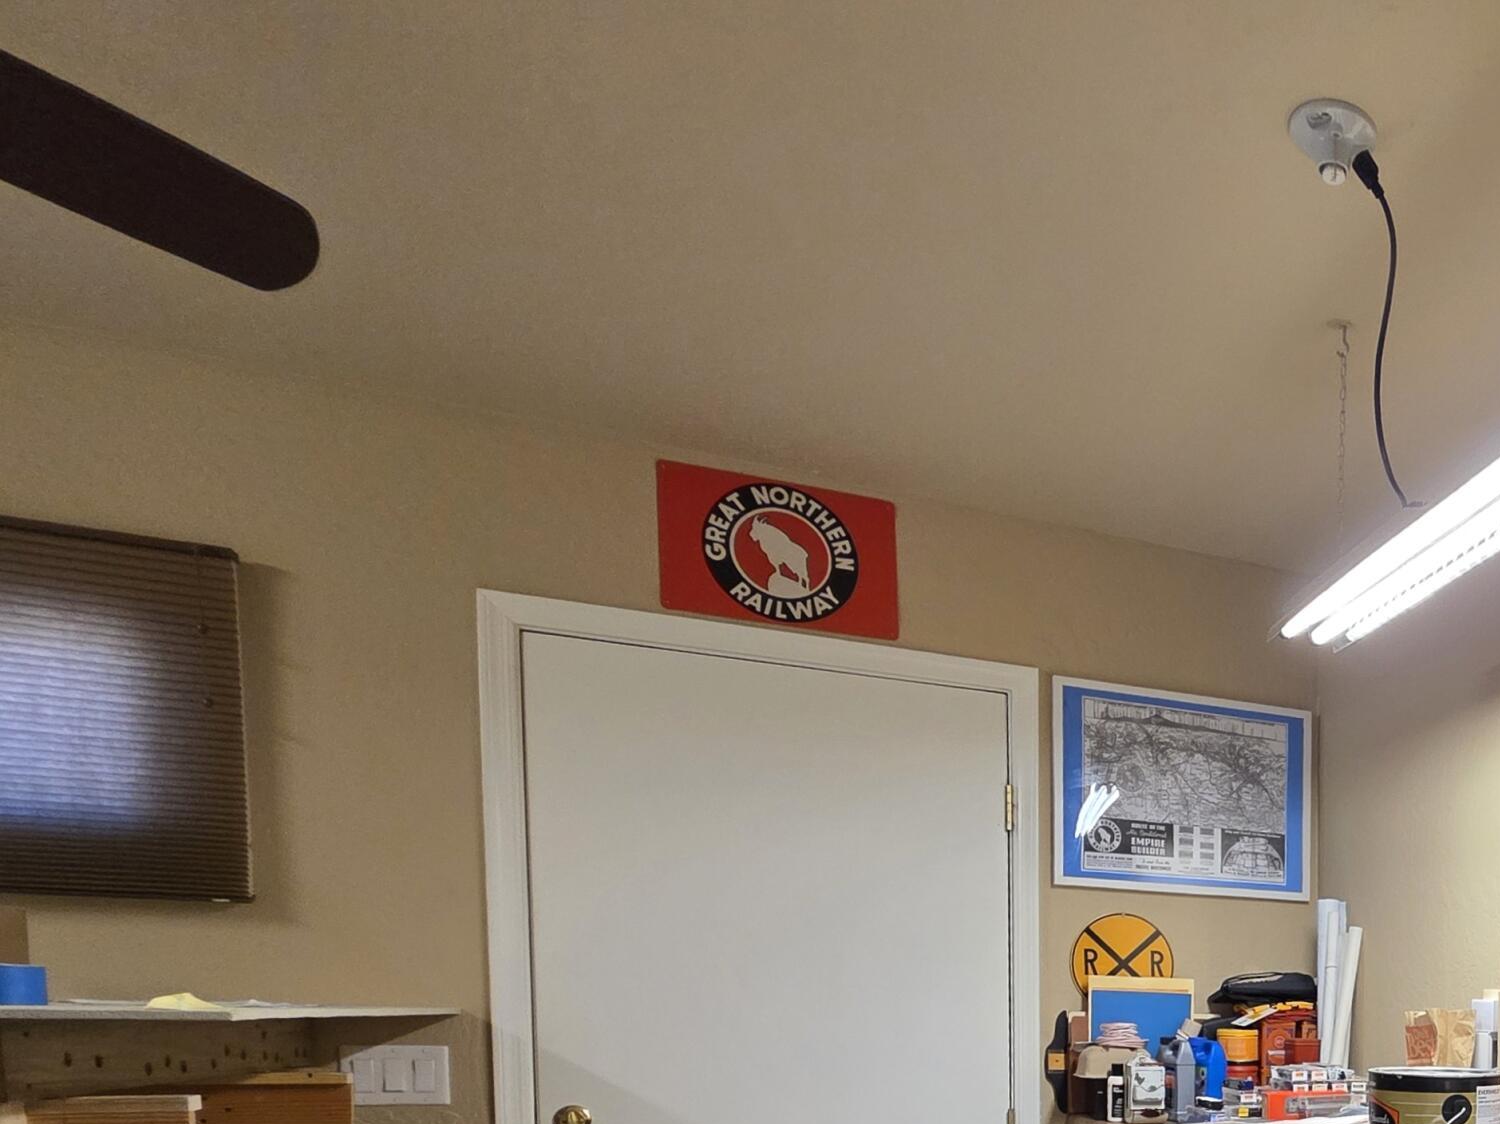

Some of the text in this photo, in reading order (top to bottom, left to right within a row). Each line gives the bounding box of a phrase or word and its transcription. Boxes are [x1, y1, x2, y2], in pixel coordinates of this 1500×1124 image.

[705, 486, 855, 572] GREAT NORTHERN
[729, 586, 839, 620] RAILWAY
[1131, 837, 1165, 848] EMPIRE
[1131, 846, 1165, 856] BUILDER
[1083, 948, 1164, 977] R R
